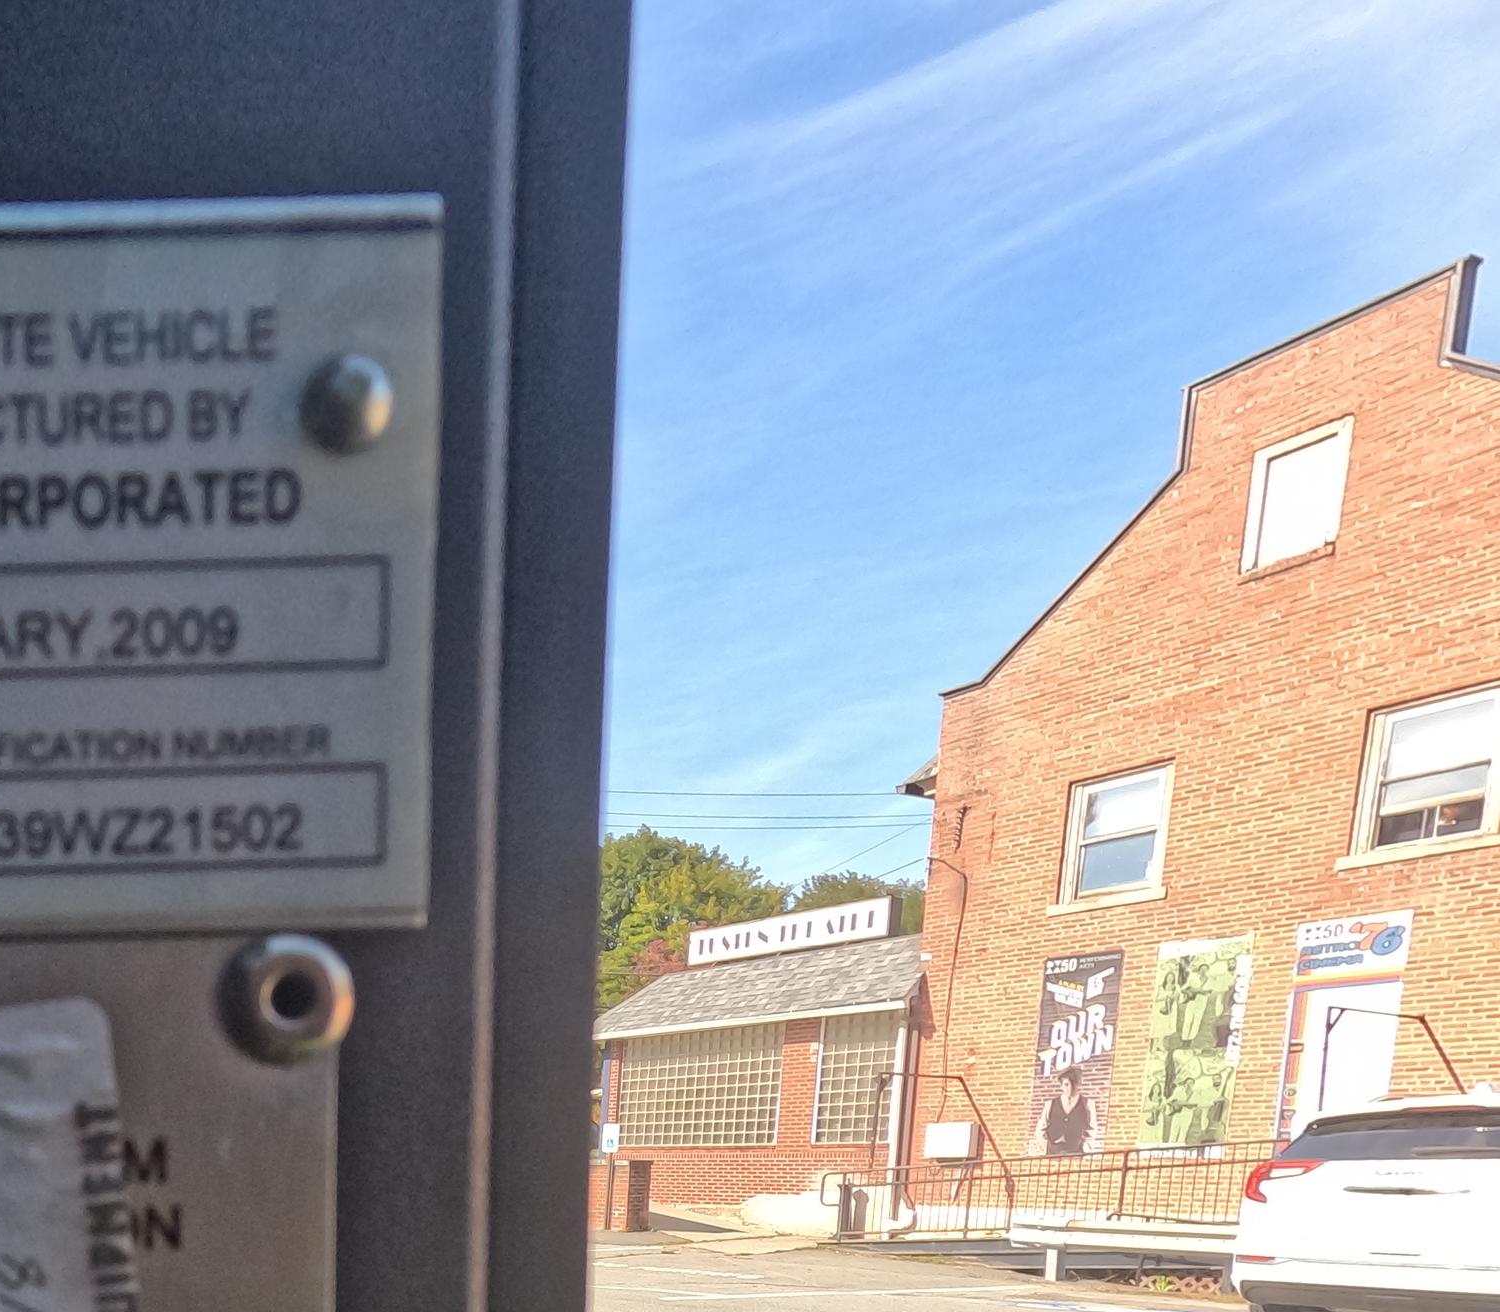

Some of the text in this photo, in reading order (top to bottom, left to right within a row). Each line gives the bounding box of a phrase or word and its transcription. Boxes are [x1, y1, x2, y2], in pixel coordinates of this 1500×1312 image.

[69, 305, 277, 367] VEHICLE
[187, 387, 252, 442] BY
[110, 605, 239, 659] 2009
[171, 724, 331, 761] NUMBER
[1038, 1024, 1114, 1076] TOWN
[1050, 1004, 1106, 1048] OUR
